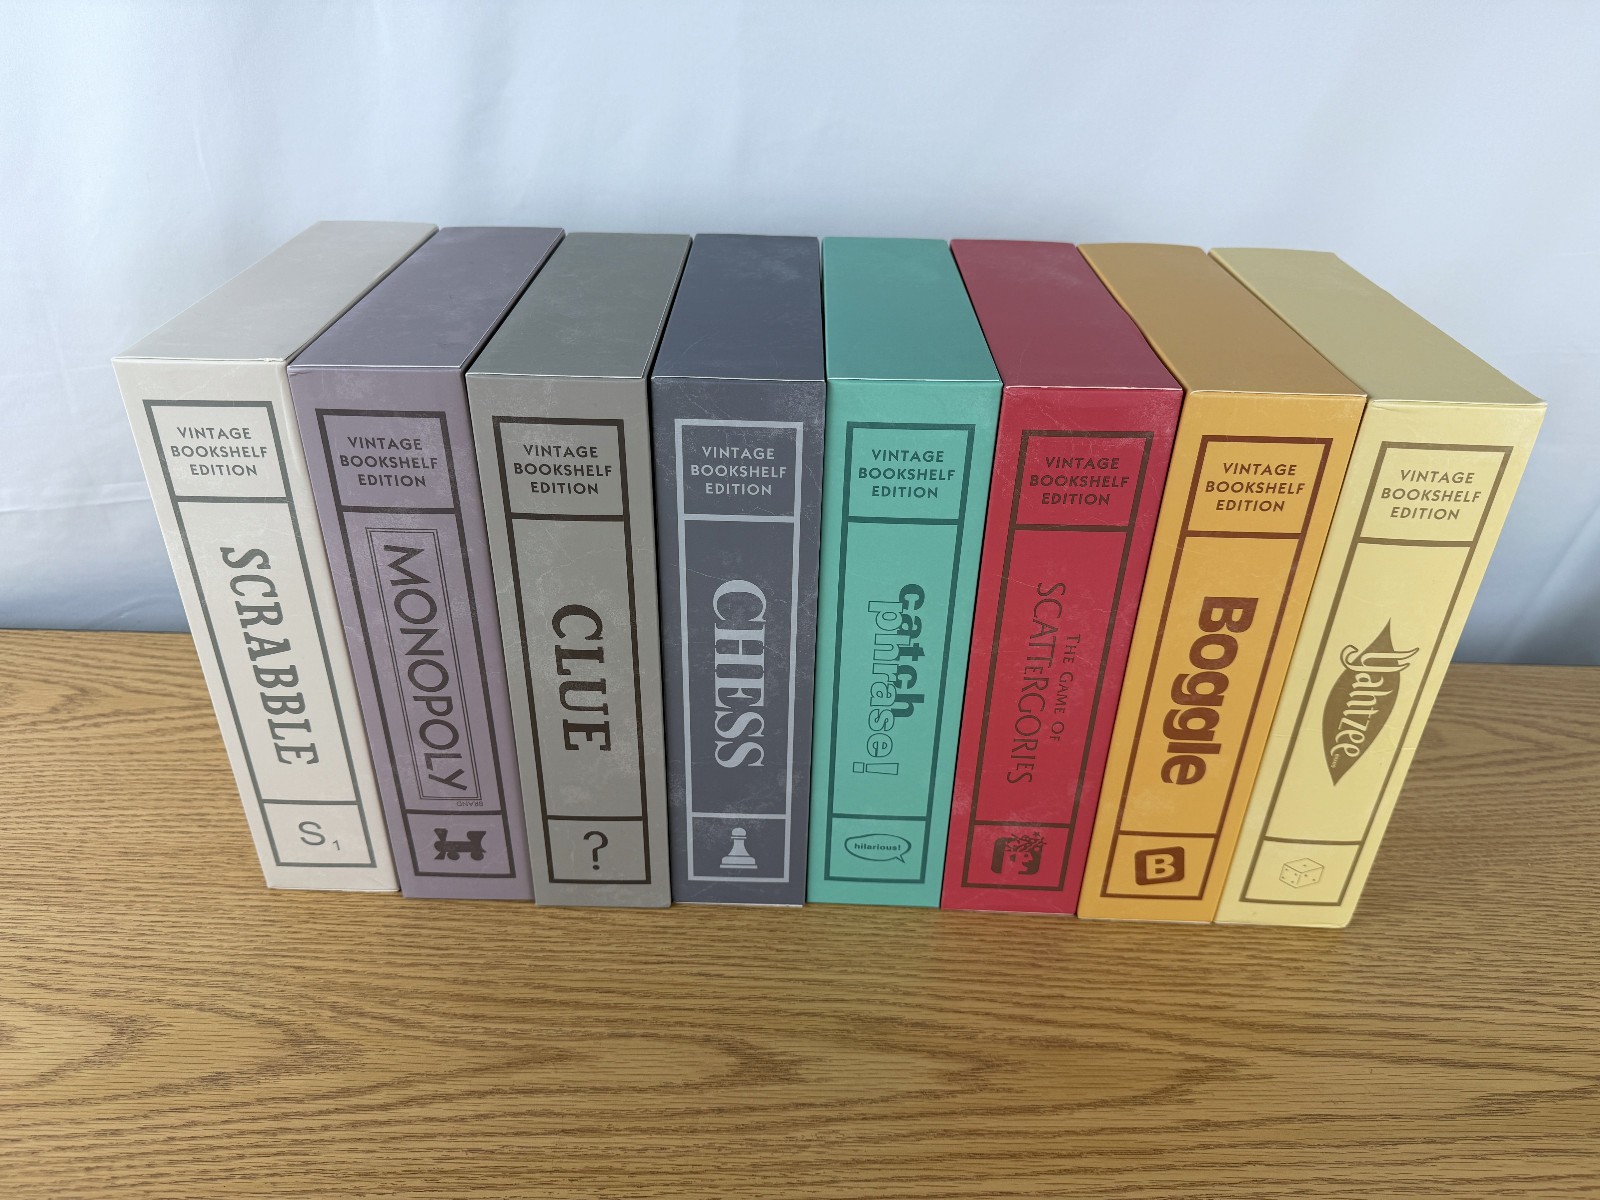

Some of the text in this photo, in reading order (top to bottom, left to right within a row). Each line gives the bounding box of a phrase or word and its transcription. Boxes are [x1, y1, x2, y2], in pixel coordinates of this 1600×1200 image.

[177, 426, 252, 441] VINTAGE
[170, 444, 268, 459] BOOKSHELF
[347, 436, 423, 451] VINTAGE
[523, 443, 599, 459] VINTAGE
[702, 445, 775, 461] VINTAGE
[871, 449, 945, 463] VINTAGE
[190, 463, 259, 477] EDITION
[339, 454, 439, 470] BOOKSHELF
[513, 462, 613, 478] BOOKSHELF
[1044, 456, 1120, 470] VINTAGE
[1222, 462, 1299, 477] VINTAGE
[690, 463, 788, 479] BOOKSHELF
[858, 466, 956, 482] BOOKSHELF
[1399, 469, 1476, 485] VINTAGE
[358, 473, 427, 488] EDITION
[530, 480, 600, 496] EDITION
[1029, 473, 1130, 489] BOOKSHELF
[1204, 480, 1305, 496] BOOKSHELF
[705, 482, 773, 496] EDITION
[871, 485, 939, 499] EDITION
[1380, 487, 1482, 504] BOOKSHELF
[1041, 491, 1111, 506] EDITION
[1215, 498, 1286, 513] EDITION
[1389, 505, 1461, 521] EDITION
[220, 546, 319, 766] SCRABBLE
[894, 583, 926, 718] catch
[383, 544, 468, 791] MONOPOLY
[713, 579, 767, 769] CHESS
[552, 604, 611, 752] CLUE
[1007, 582, 1065, 784] SCATTERGORIES
[853, 600, 904, 776] phrase!
[1049, 634, 1081, 742] THE GAME OF
[1160, 596, 1260, 786] Boggle
[1330, 642, 1420, 758] Yahtzee
[299, 821, 341, 851] S 1
[854, 843, 902, 852] hilarious!
[1145, 854, 1175, 879] B
